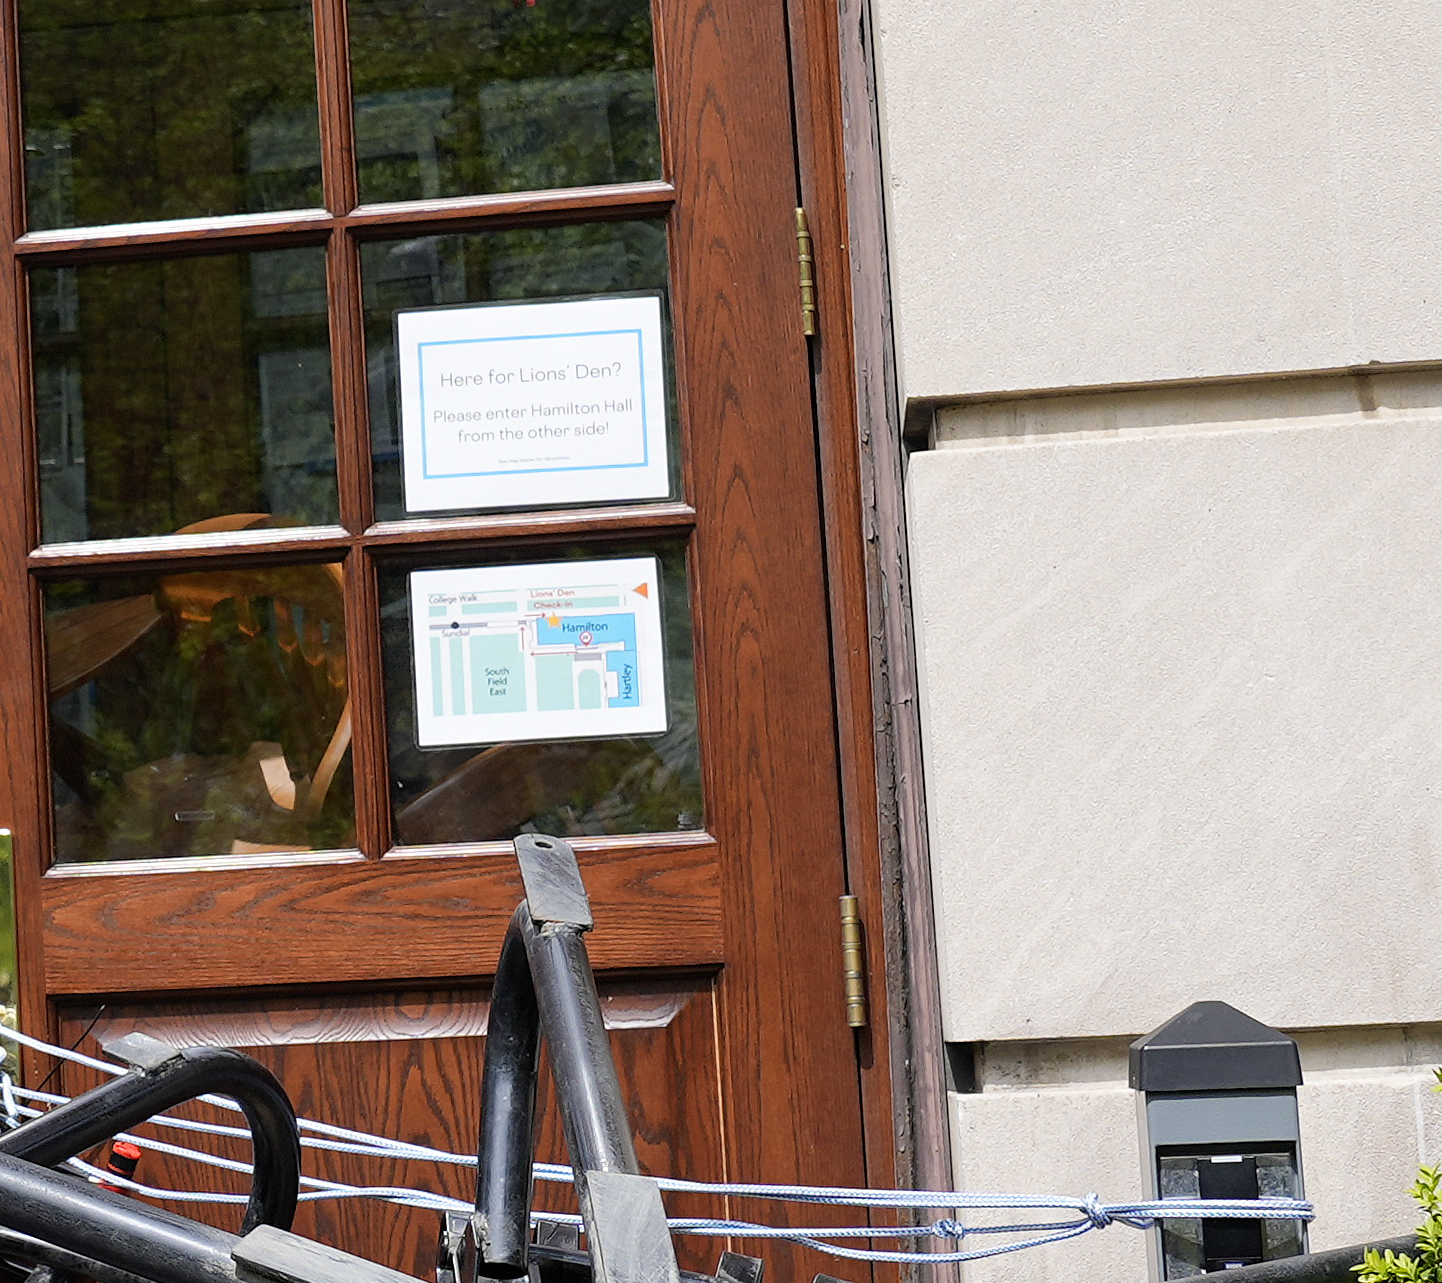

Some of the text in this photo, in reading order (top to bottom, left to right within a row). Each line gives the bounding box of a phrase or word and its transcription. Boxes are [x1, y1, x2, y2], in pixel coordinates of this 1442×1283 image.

[440, 372, 483, 388] Here
[488, 368, 515, 385] for
[575, 361, 622, 380] Den?
[433, 398, 633, 424] Please enter Hamilton Hall
[458, 421, 610, 444] from the other side!
[561, 622, 609, 633] Hamilton
[484, 667, 510, 677] South
[487, 677, 508, 687] Field
[621, 663, 634, 700] Hartley
[489, 687, 507, 697] East
